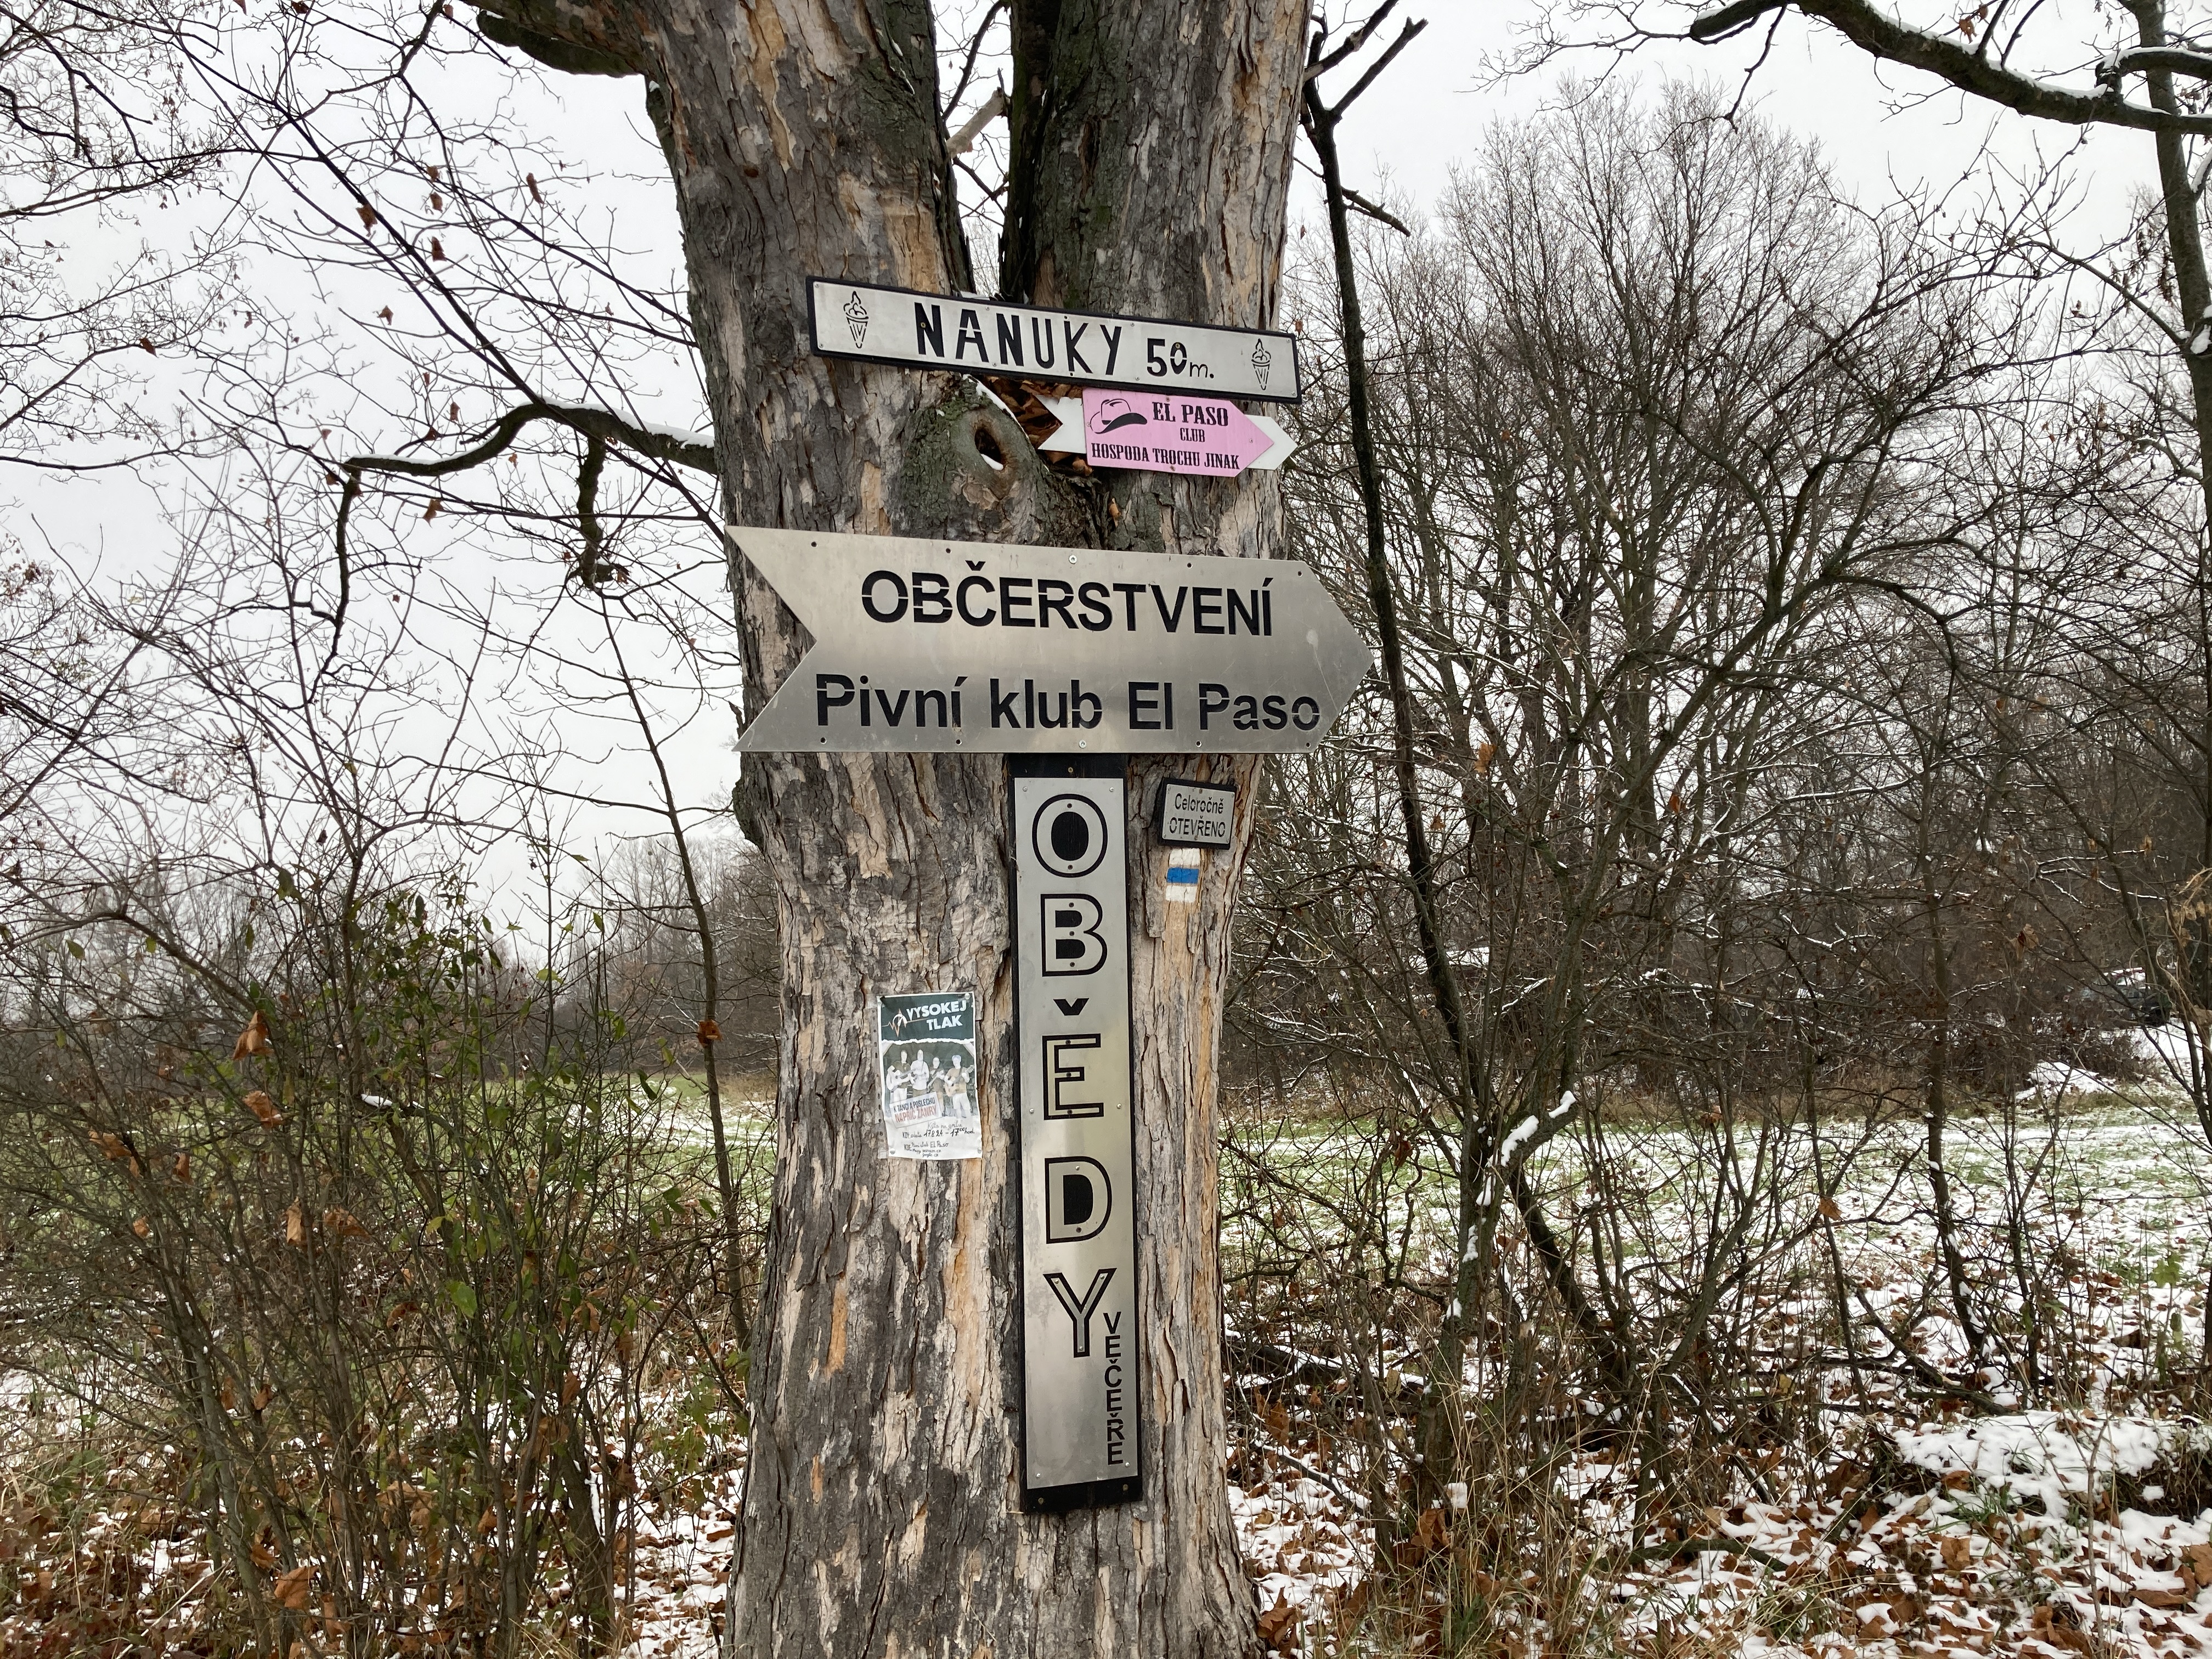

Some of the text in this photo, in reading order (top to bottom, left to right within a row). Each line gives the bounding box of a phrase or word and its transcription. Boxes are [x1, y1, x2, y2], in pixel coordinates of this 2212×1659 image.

[914, 302, 1122, 375] NANUKY
[1152, 402, 1228, 426] EL PASO
[1180, 427, 1205, 442] CLUB
[1091, 443, 1240, 470] HOSPODA TROCHU JINAK
[861, 561, 1273, 636] OBČERSTVENÍ
[816, 674, 1321, 731] Pivní klub El Paso
[1175, 793, 1224, 814] Celoročně
[1169, 816, 1226, 838] OTEVŘENO
[906, 1000, 967, 1021] VYSOKEJ
[926, 1015, 963, 1031] TLAK
[1032, 793, 1117, 1358] OBĚDY
[913, 1097, 935, 1109] POSLECHU
[1103, 1312, 1125, 1465] VEČEŘE
